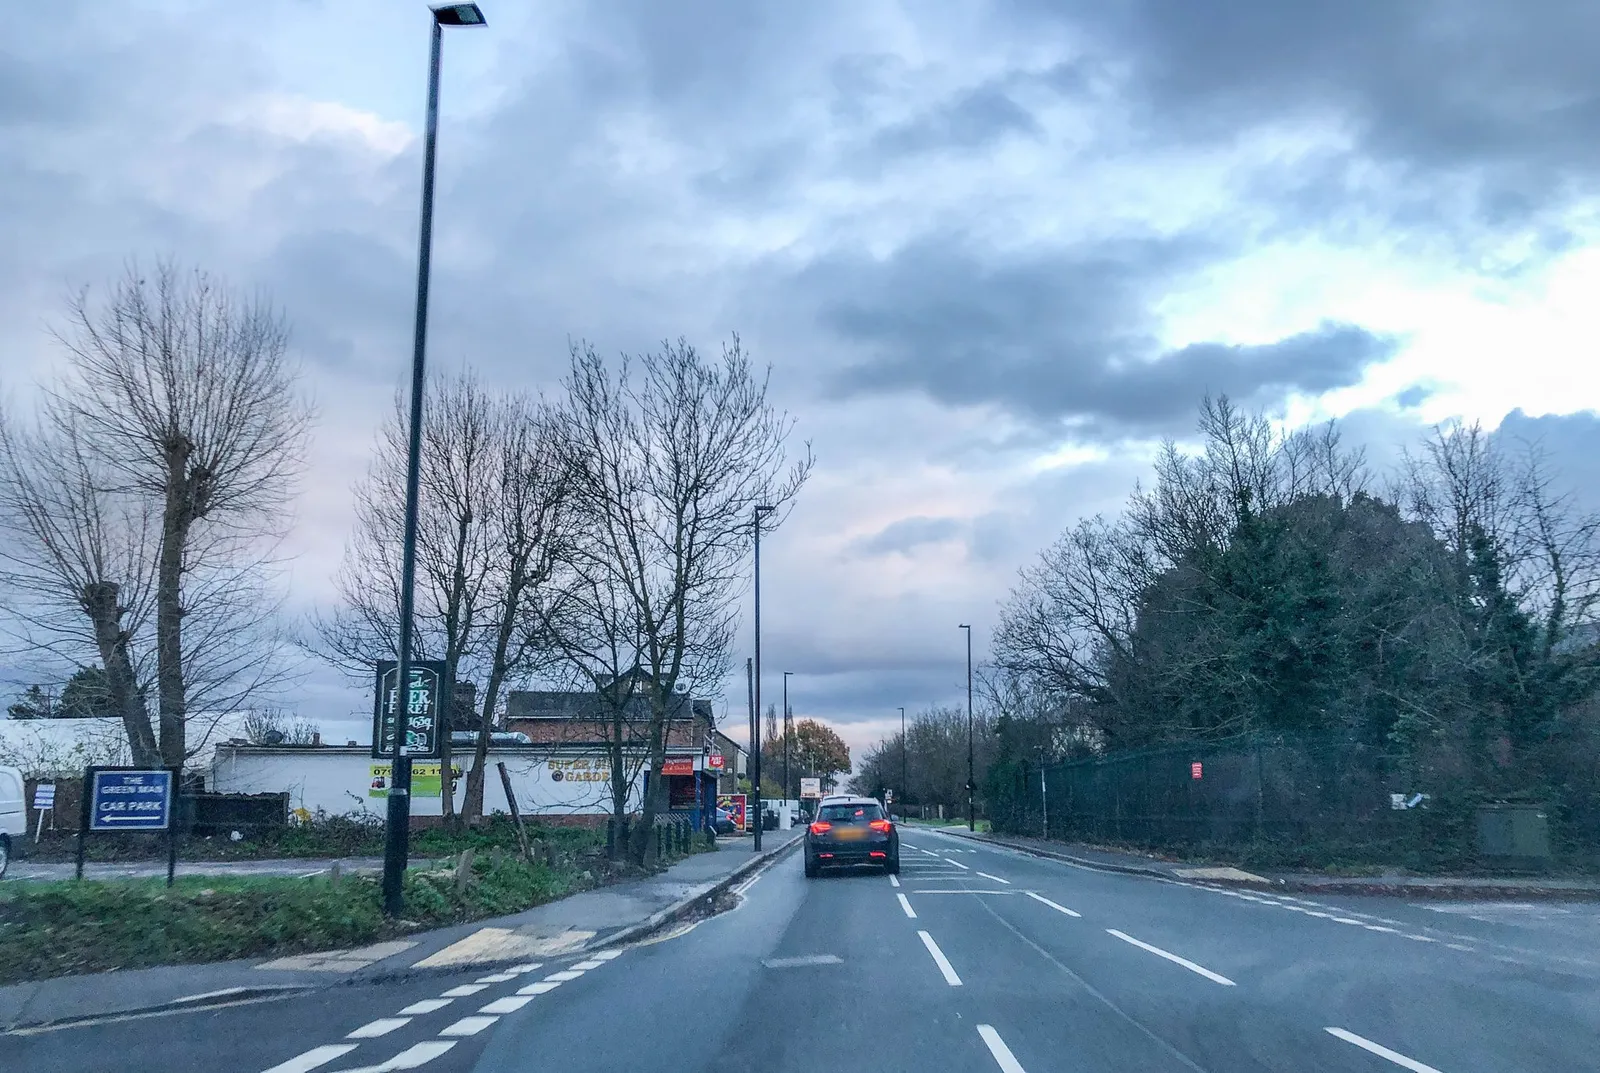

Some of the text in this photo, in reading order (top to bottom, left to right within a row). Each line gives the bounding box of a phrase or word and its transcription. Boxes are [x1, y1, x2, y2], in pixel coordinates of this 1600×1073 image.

[388, 690, 431, 704] BER
[387, 704, 428, 715] HRE!
[123, 776, 144, 785] THE
[101, 785, 164, 794] GREEN MAN
[100, 801, 162, 811] CAR PARK
